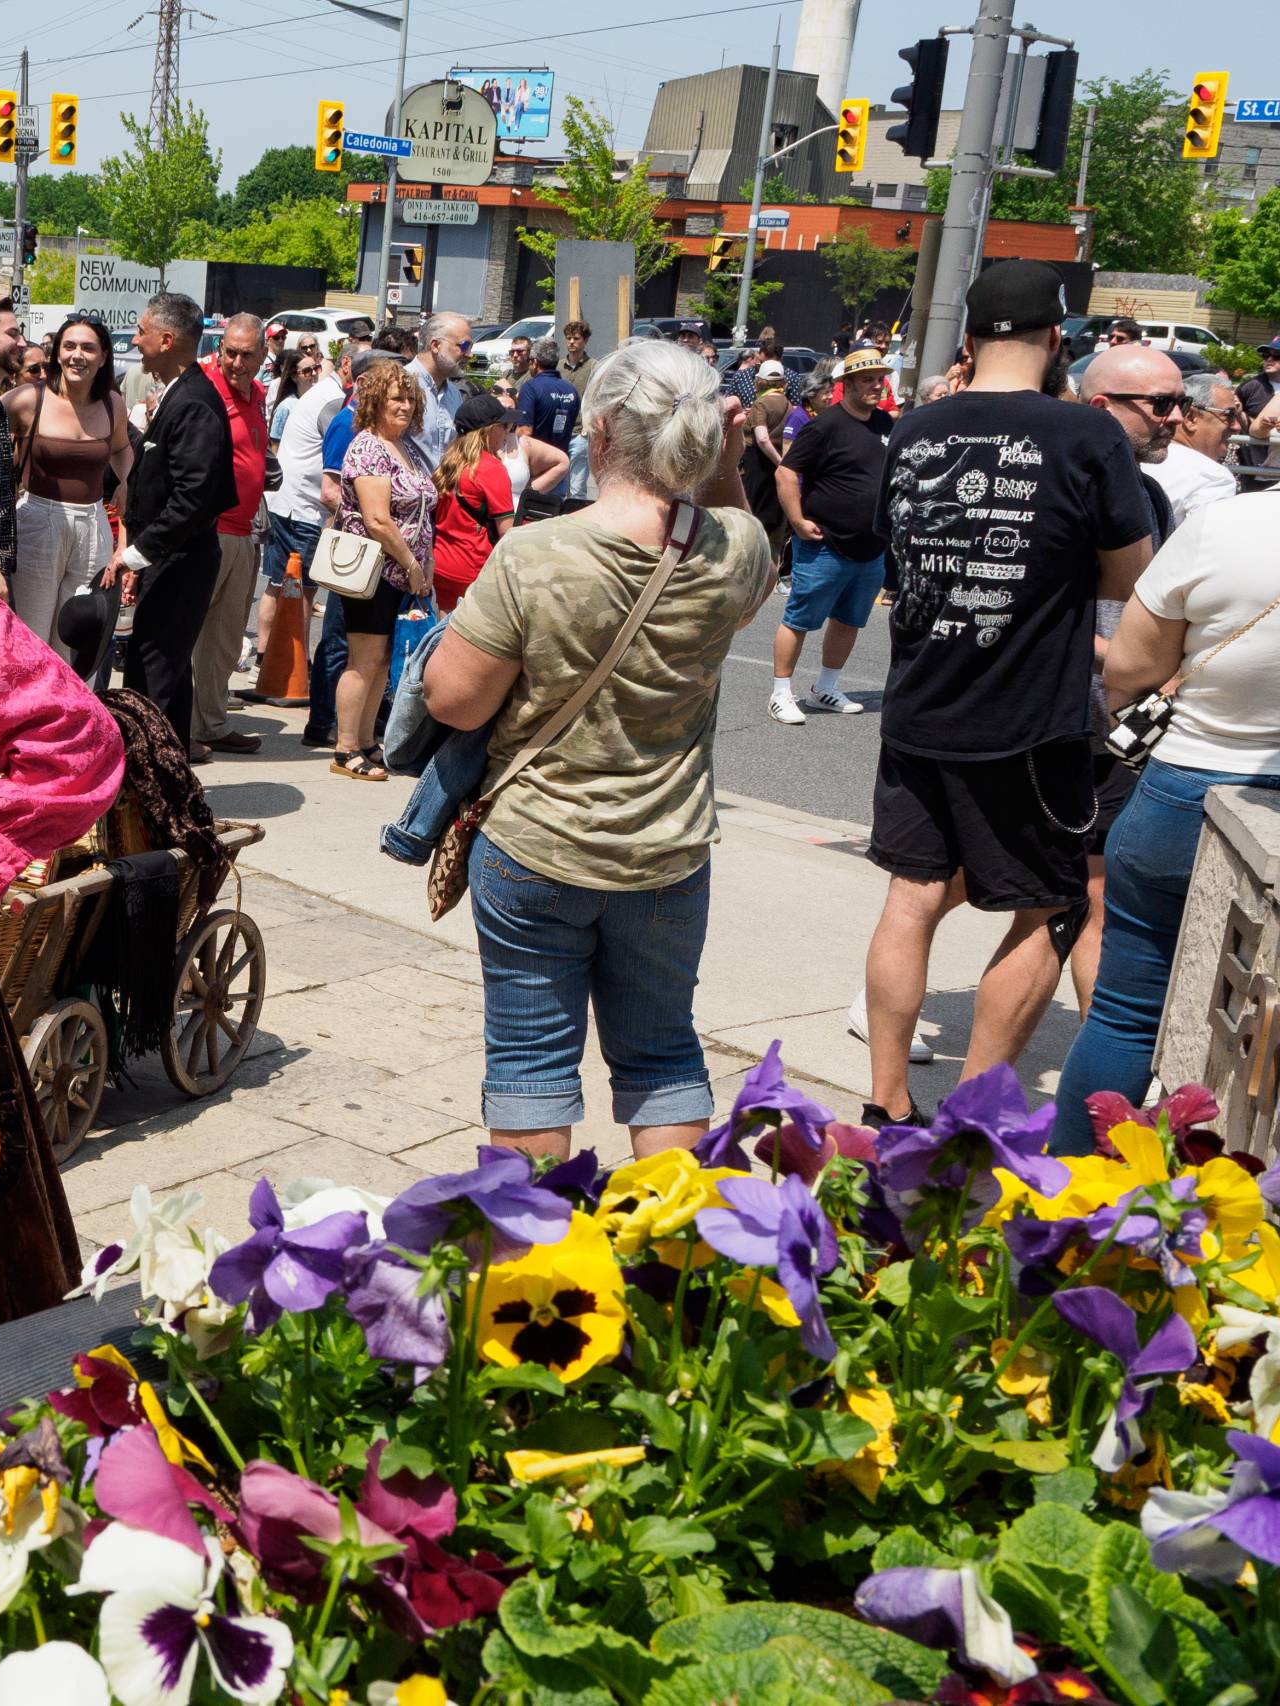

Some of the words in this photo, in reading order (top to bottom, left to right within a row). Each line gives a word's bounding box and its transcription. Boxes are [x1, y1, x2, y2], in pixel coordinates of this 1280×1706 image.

[18, 108, 34, 116] LEFT
[1242, 101, 1260, 116] St.
[18, 118, 34, 126] TURN
[16, 128, 37, 138] SIGNAL
[404, 118, 488, 145] KAPITAL
[346, 134, 398, 152] Caledonia
[412, 144, 450, 160] STAURANT
[452, 146, 460, 160] &
[463, 146, 488, 163] GRILL
[432, 168, 452, 176] 1500
[408, 201, 424, 210] DINE
[443, 202, 459, 212] TAKE
[462, 204, 474, 212] OUT
[413, 212, 468, 222] 416-657-4000
[80, 260, 114, 276] NEW
[80, 276, 170, 294] COMMUNITY
[30, 312, 44, 324] TER
[78, 308, 138, 324] COMING
[990, 509, 1036, 522] DOUGLAS
[968, 564, 1024, 572] DAMAGE
[972, 570, 1022, 578] DEVICE
